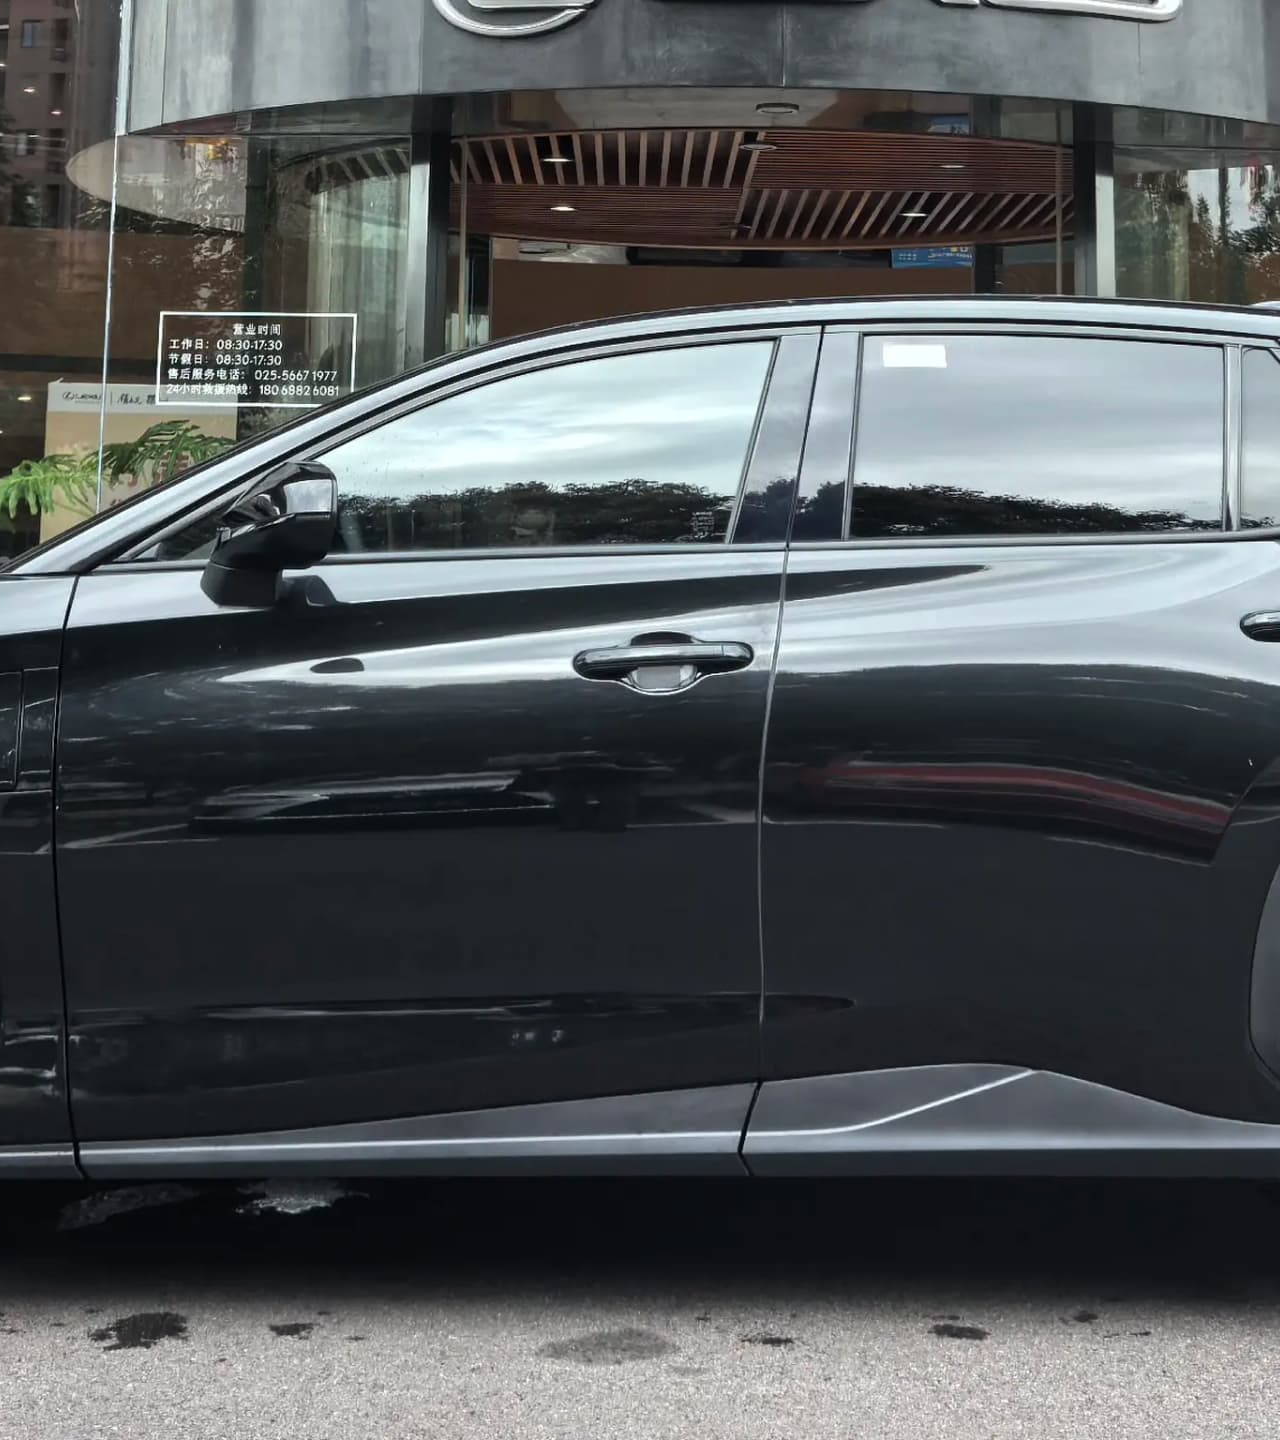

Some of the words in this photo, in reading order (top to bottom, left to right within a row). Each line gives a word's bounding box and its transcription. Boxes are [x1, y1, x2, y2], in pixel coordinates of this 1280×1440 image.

[232, 323, 282, 336] 营业时间
[216, 340, 283, 351] 08:30-17:30
[215, 354, 282, 366] 08:30-17:30
